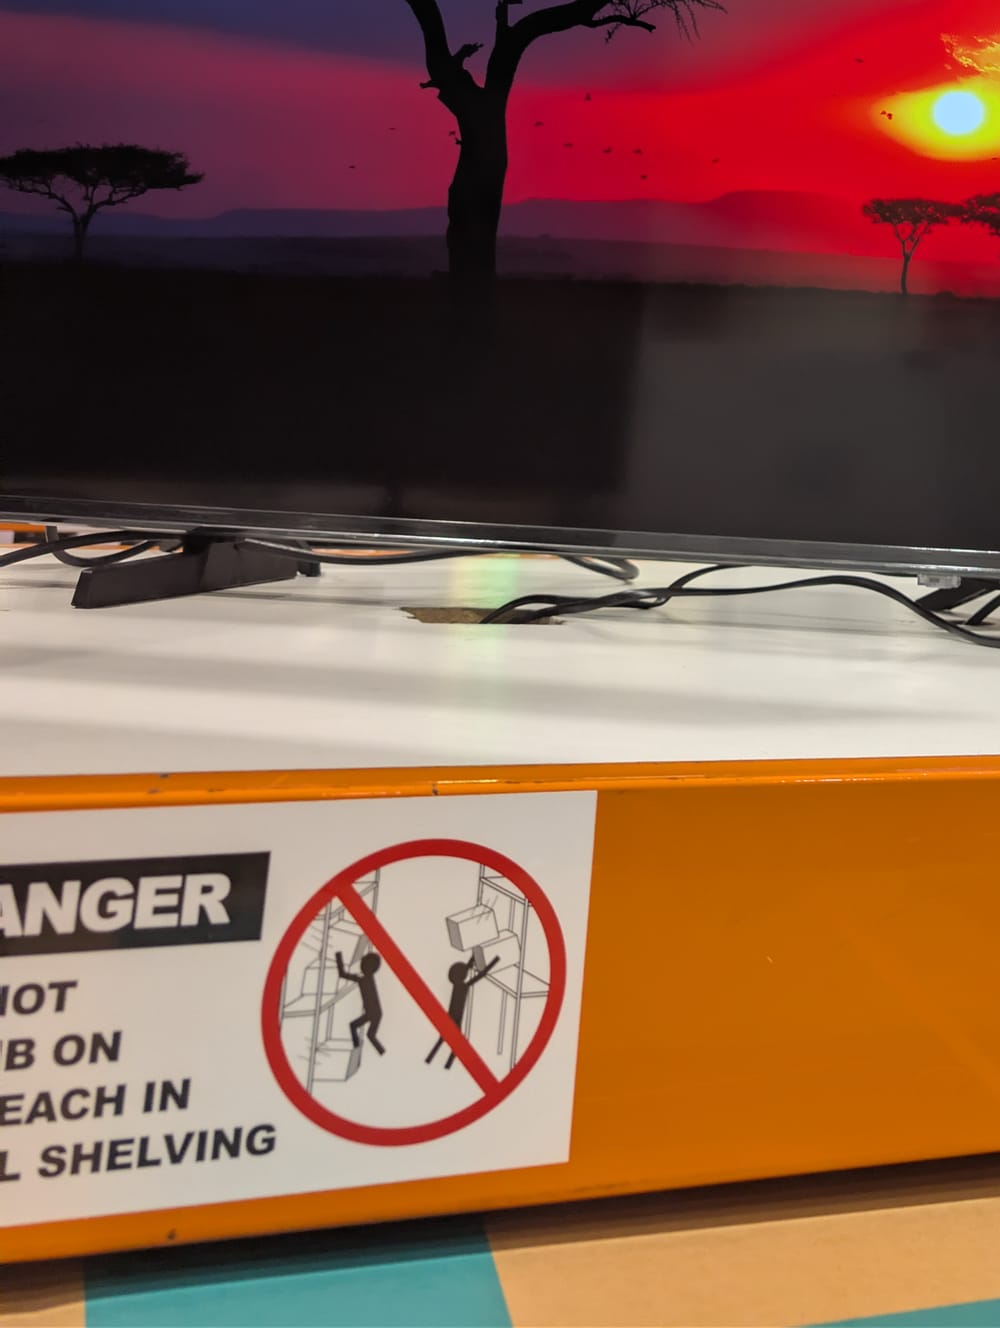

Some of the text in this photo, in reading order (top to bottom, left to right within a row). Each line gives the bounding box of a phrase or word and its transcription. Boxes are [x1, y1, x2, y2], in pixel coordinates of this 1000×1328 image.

[54, 1030, 122, 1067] ON
[0, 1078, 191, 1127] EACH IN
[38, 1124, 276, 1178] SHELVING
